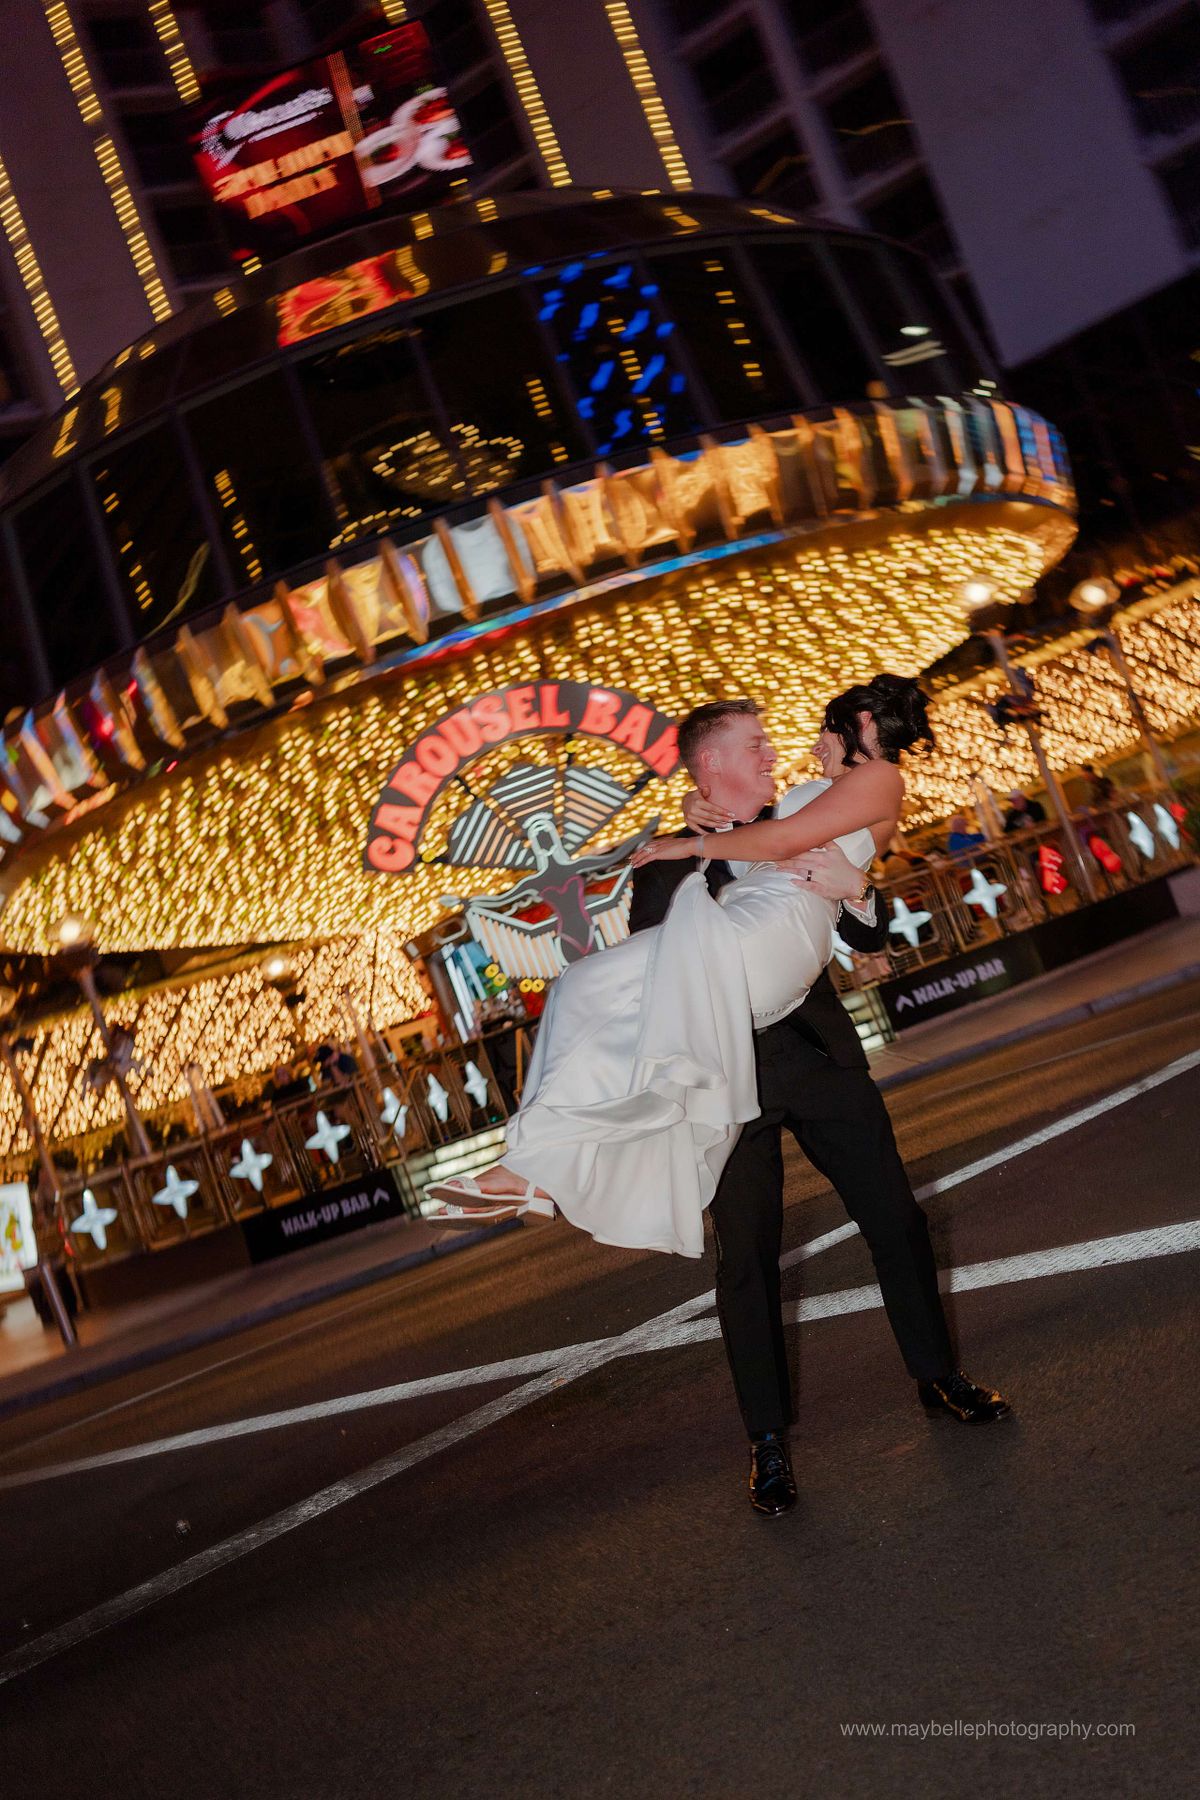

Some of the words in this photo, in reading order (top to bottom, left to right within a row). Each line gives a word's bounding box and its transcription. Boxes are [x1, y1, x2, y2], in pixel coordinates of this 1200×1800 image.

[367, 683, 571, 873] CAROUSEL
[911, 968, 978, 1006] WALK-UP
[976, 958, 1007, 983] BAR
[281, 1203, 340, 1237] WALK-UP
[341, 1193, 372, 1217] BAR
